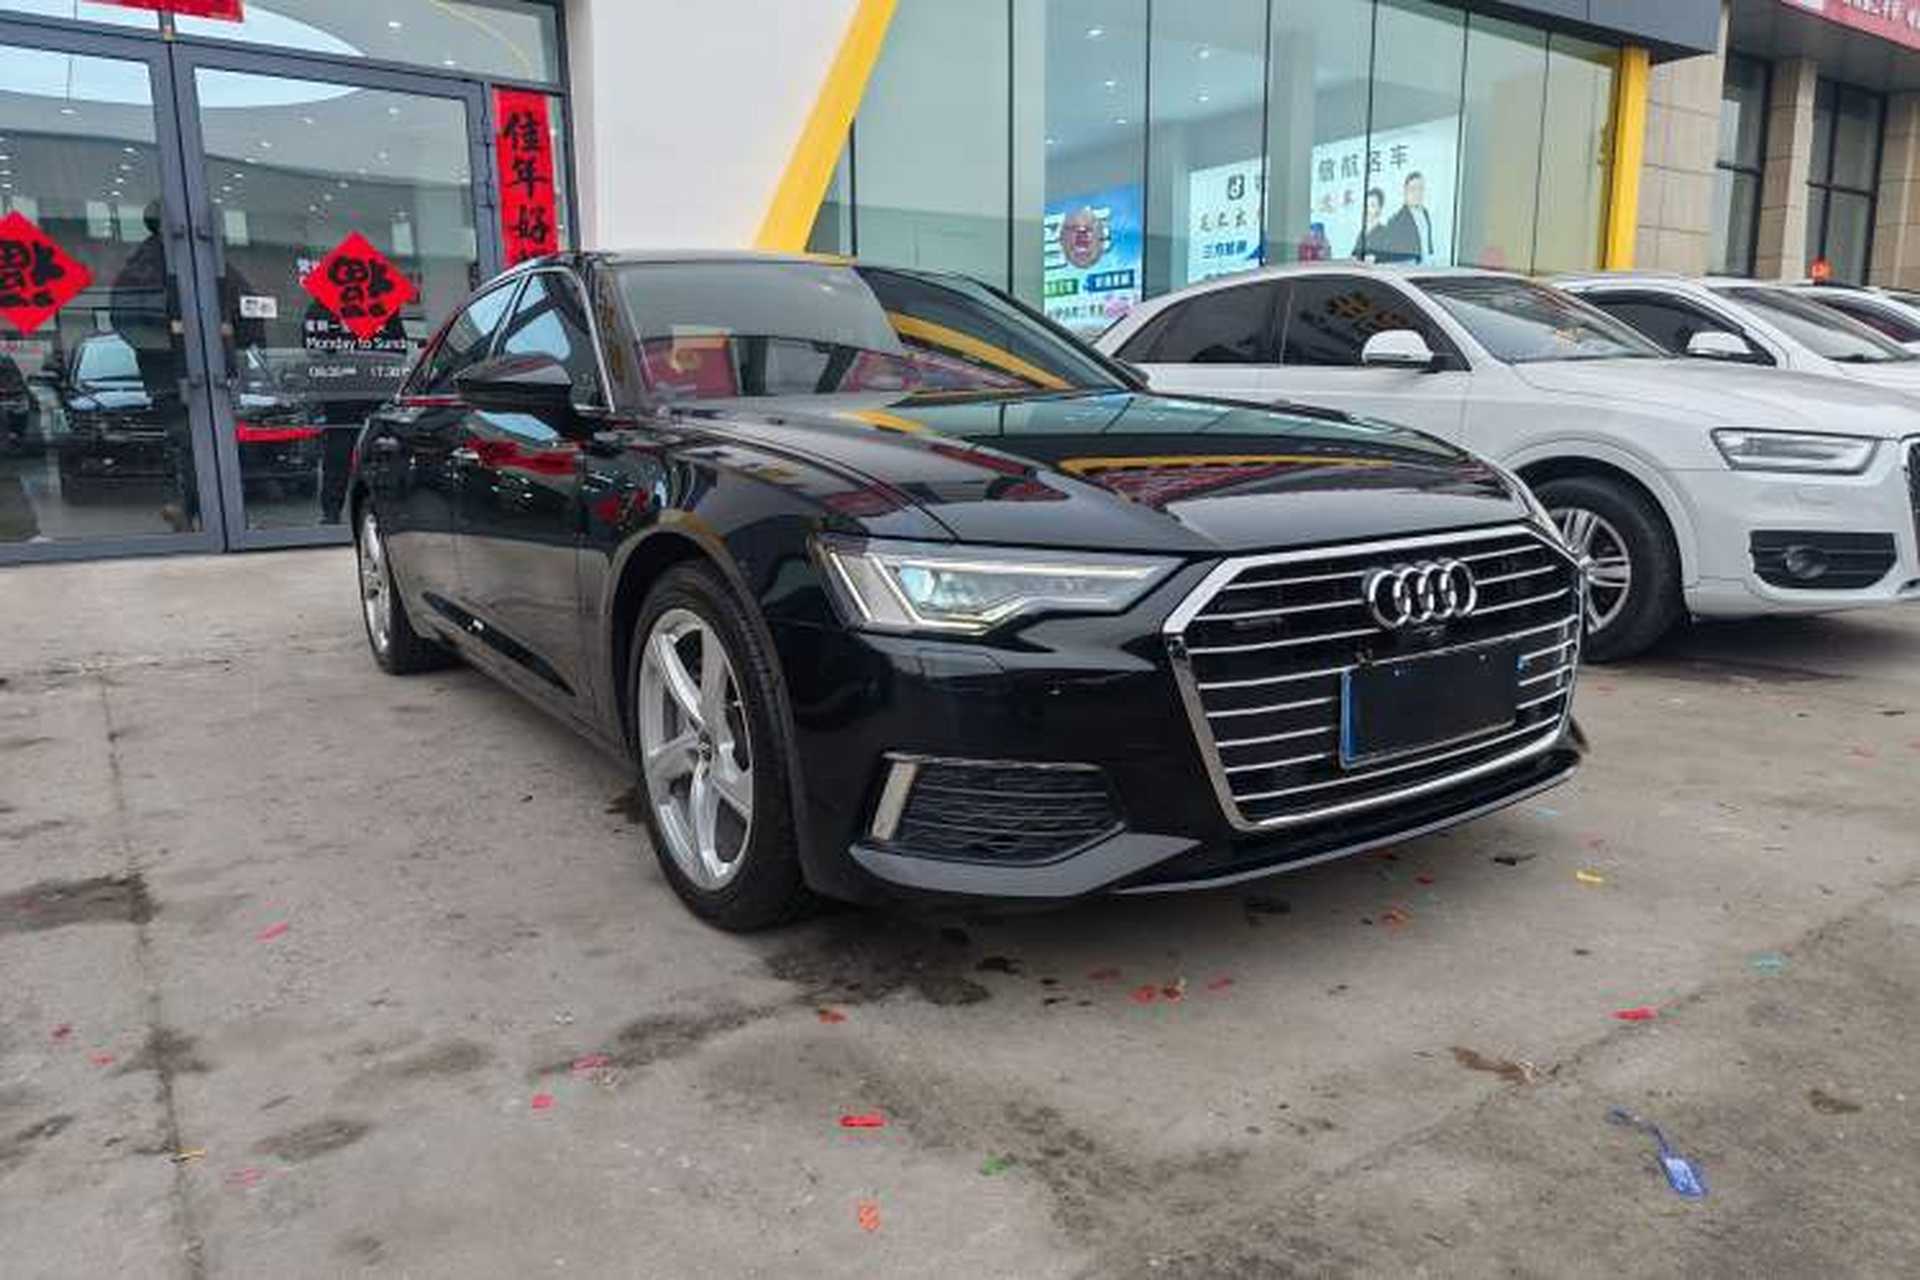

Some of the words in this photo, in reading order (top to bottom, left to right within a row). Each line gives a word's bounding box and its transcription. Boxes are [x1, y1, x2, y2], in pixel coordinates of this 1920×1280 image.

[497, 111, 554, 260] 佳年好
[327, 255, 394, 318] 福
[306, 338, 356, 353] Monday
[358, 338, 373, 350] to
[374, 338, 418, 352] Sunday
